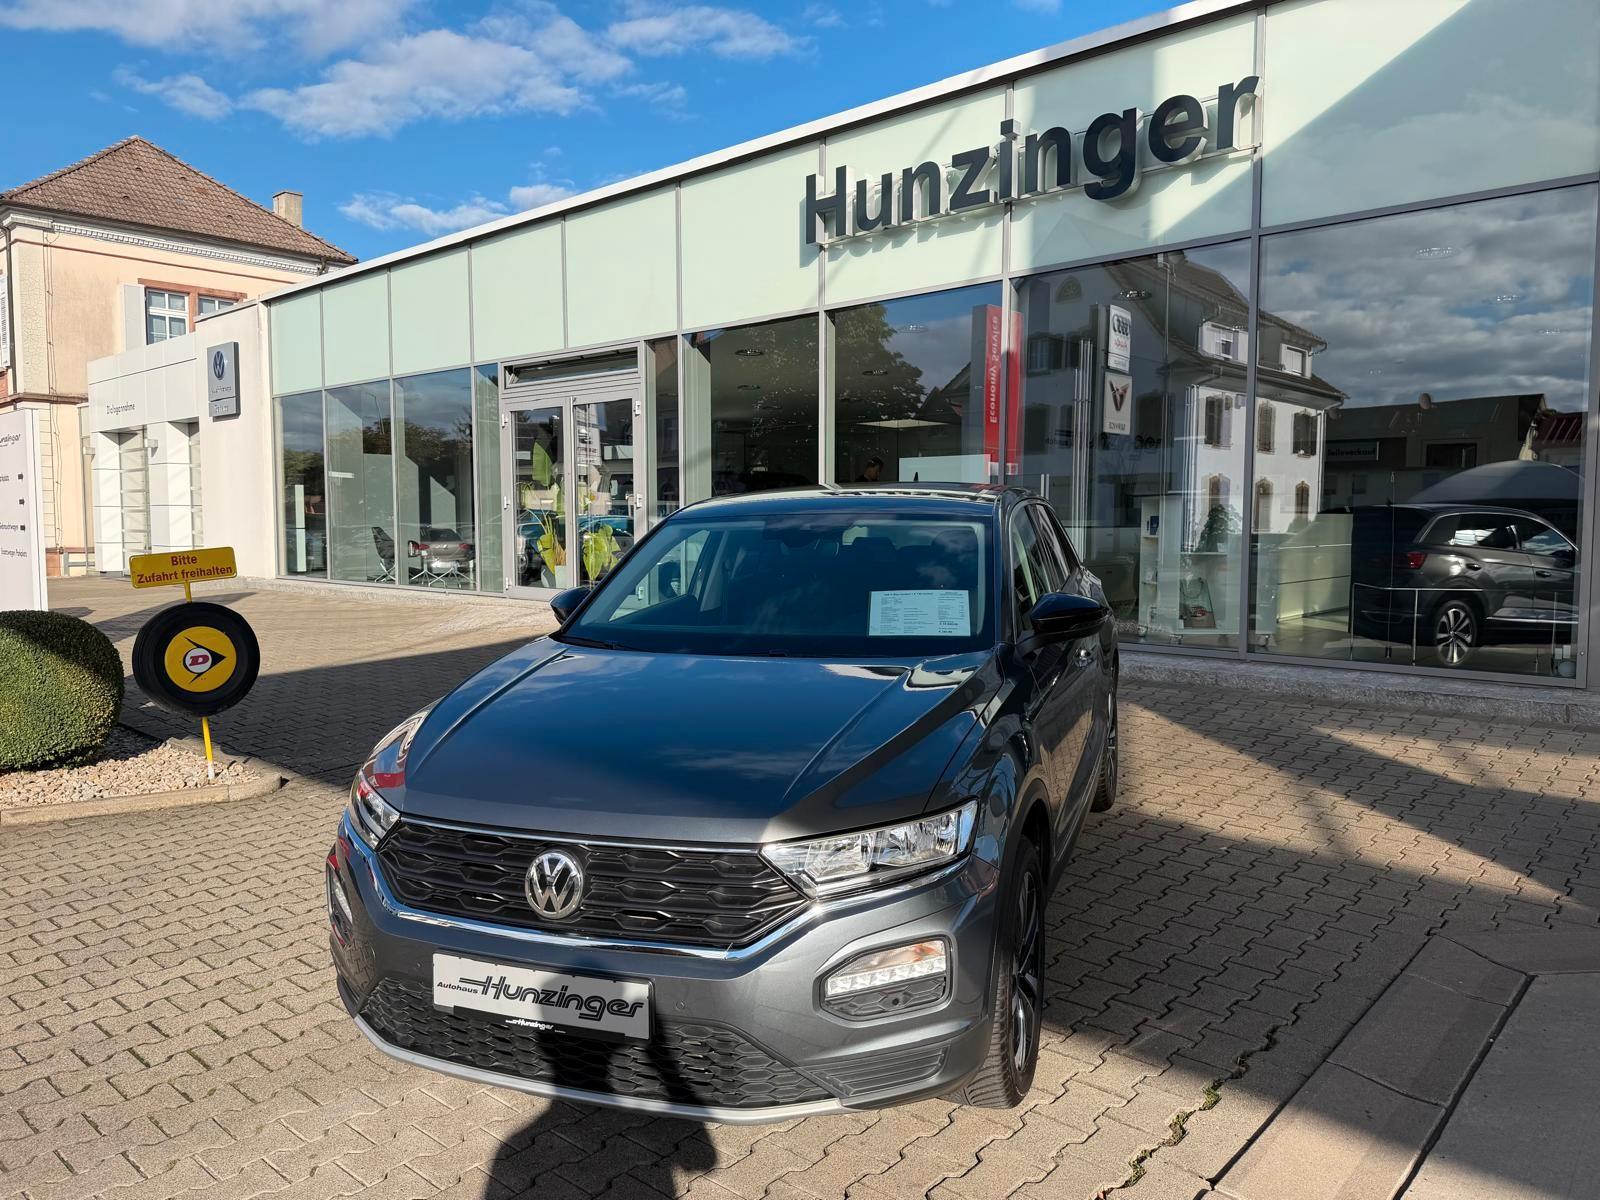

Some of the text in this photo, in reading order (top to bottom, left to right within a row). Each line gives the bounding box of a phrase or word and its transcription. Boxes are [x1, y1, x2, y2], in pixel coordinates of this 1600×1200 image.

[805, 75, 1260, 244] Hunzinger
[137, 565, 233, 585] Zufahrt freihalten
[170, 554, 198, 567] Bitte
[436, 975, 645, 1022] Autohaus Hunzinger
